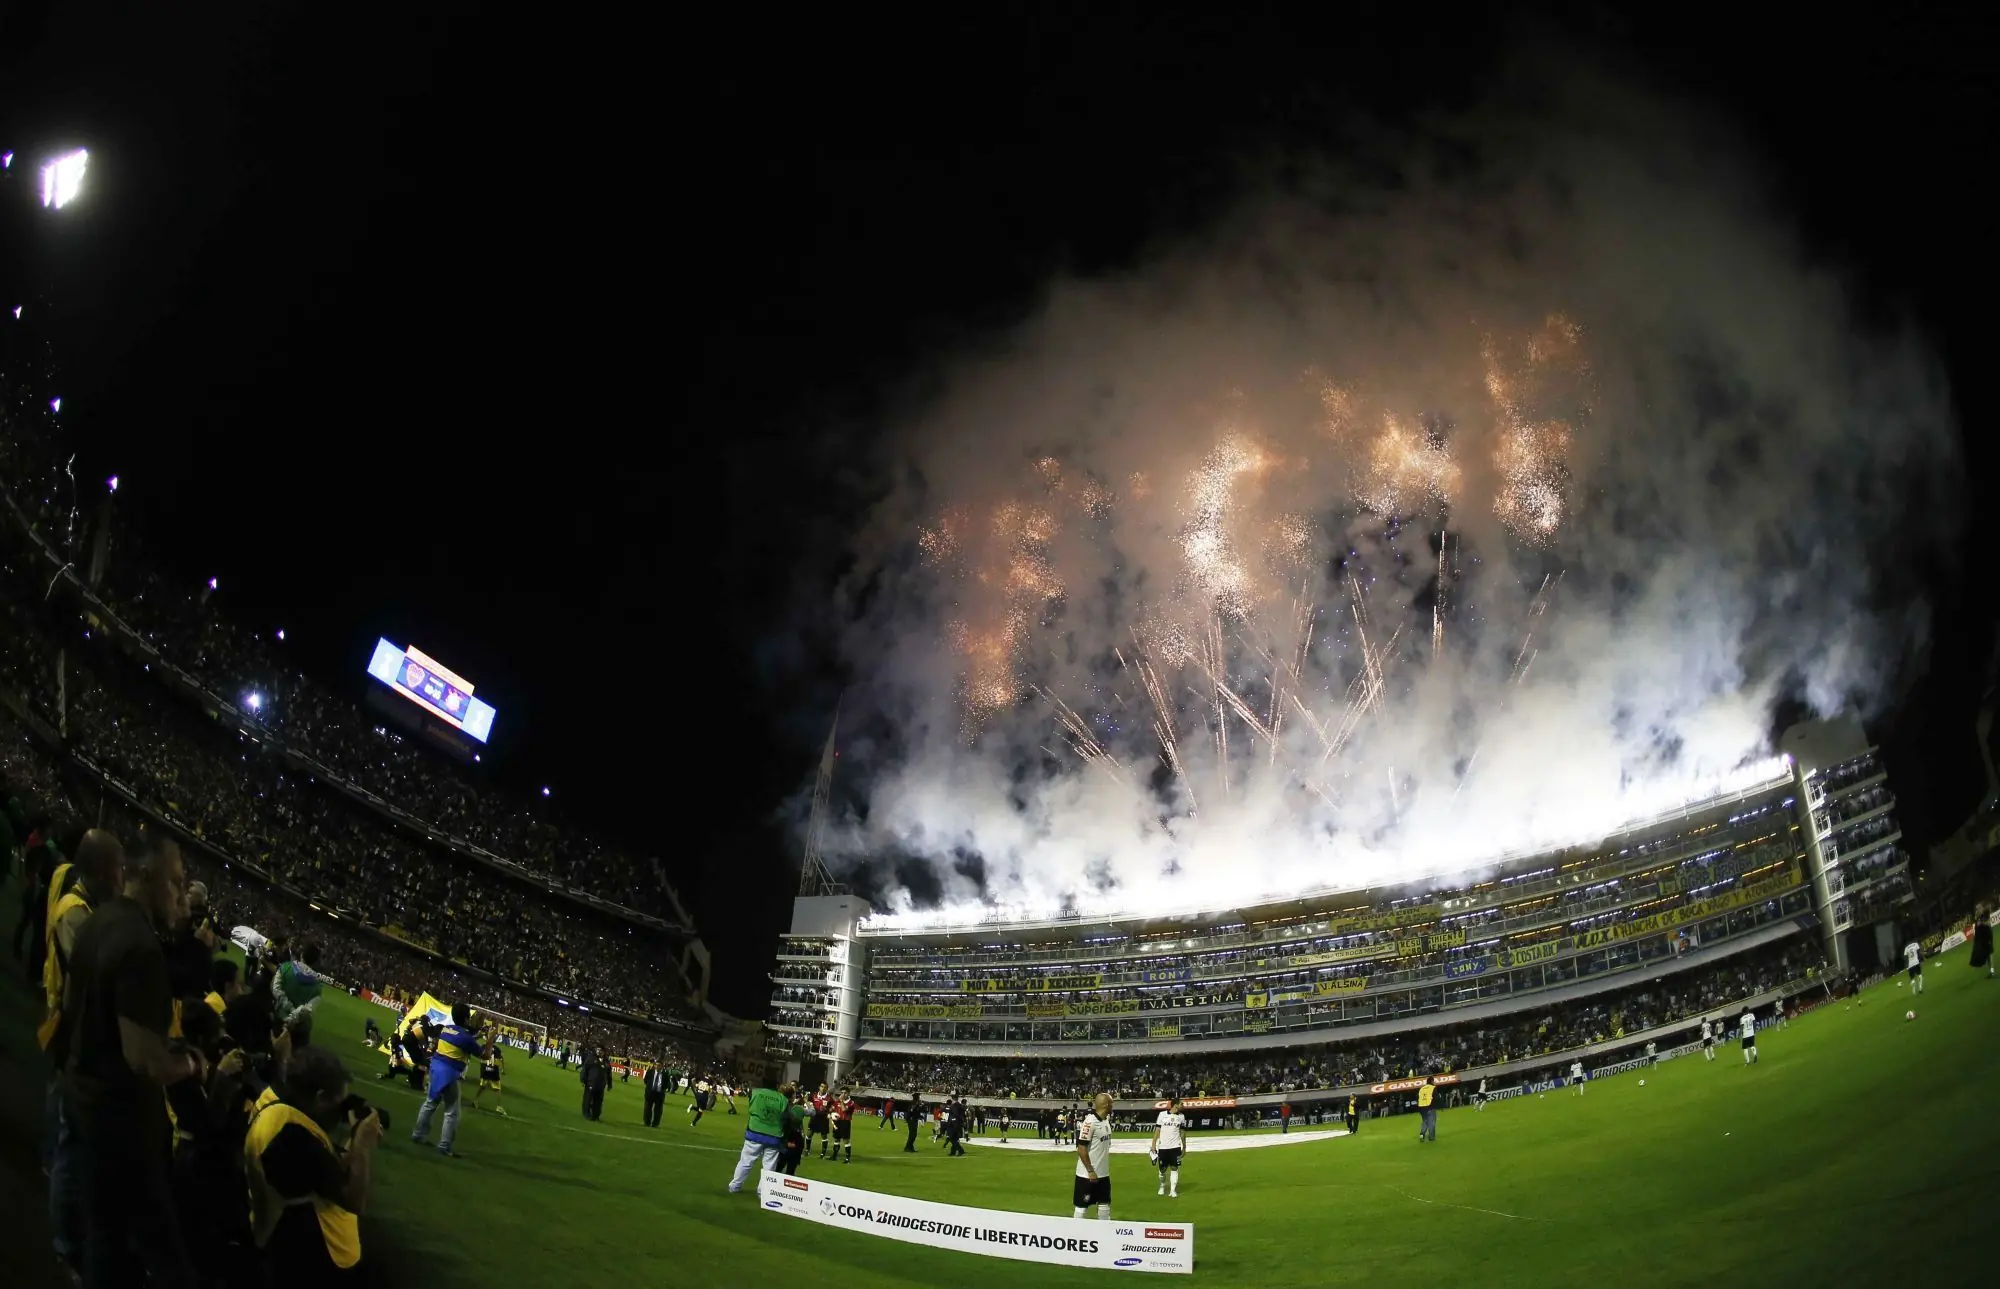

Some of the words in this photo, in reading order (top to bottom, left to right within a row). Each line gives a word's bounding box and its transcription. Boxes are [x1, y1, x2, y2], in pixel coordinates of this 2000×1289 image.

[1452, 962, 1479, 975] TONY
[1150, 970, 1187, 981] RONY
[967, 980, 994, 991] MOV.
[509, 1038, 530, 1051] VISA
[1389, 1075, 1457, 1090] GATOADE
[1529, 1081, 1556, 1093] VISA
[1562, 1072, 1587, 1086] VIA
[1082, 1121, 1091, 1140] FISK
[765, 1176, 777, 1184] VISA
[838, 1204, 874, 1222] COPA
[876, 1210, 972, 1239] BRIDGESTONE
[974, 1227, 1099, 1254] LIBERTADORES
[1115, 1228, 1134, 1236] VISA
[1153, 1230, 1183, 1238] Santander
[1121, 1244, 1176, 1254] BRIDGESTONE
